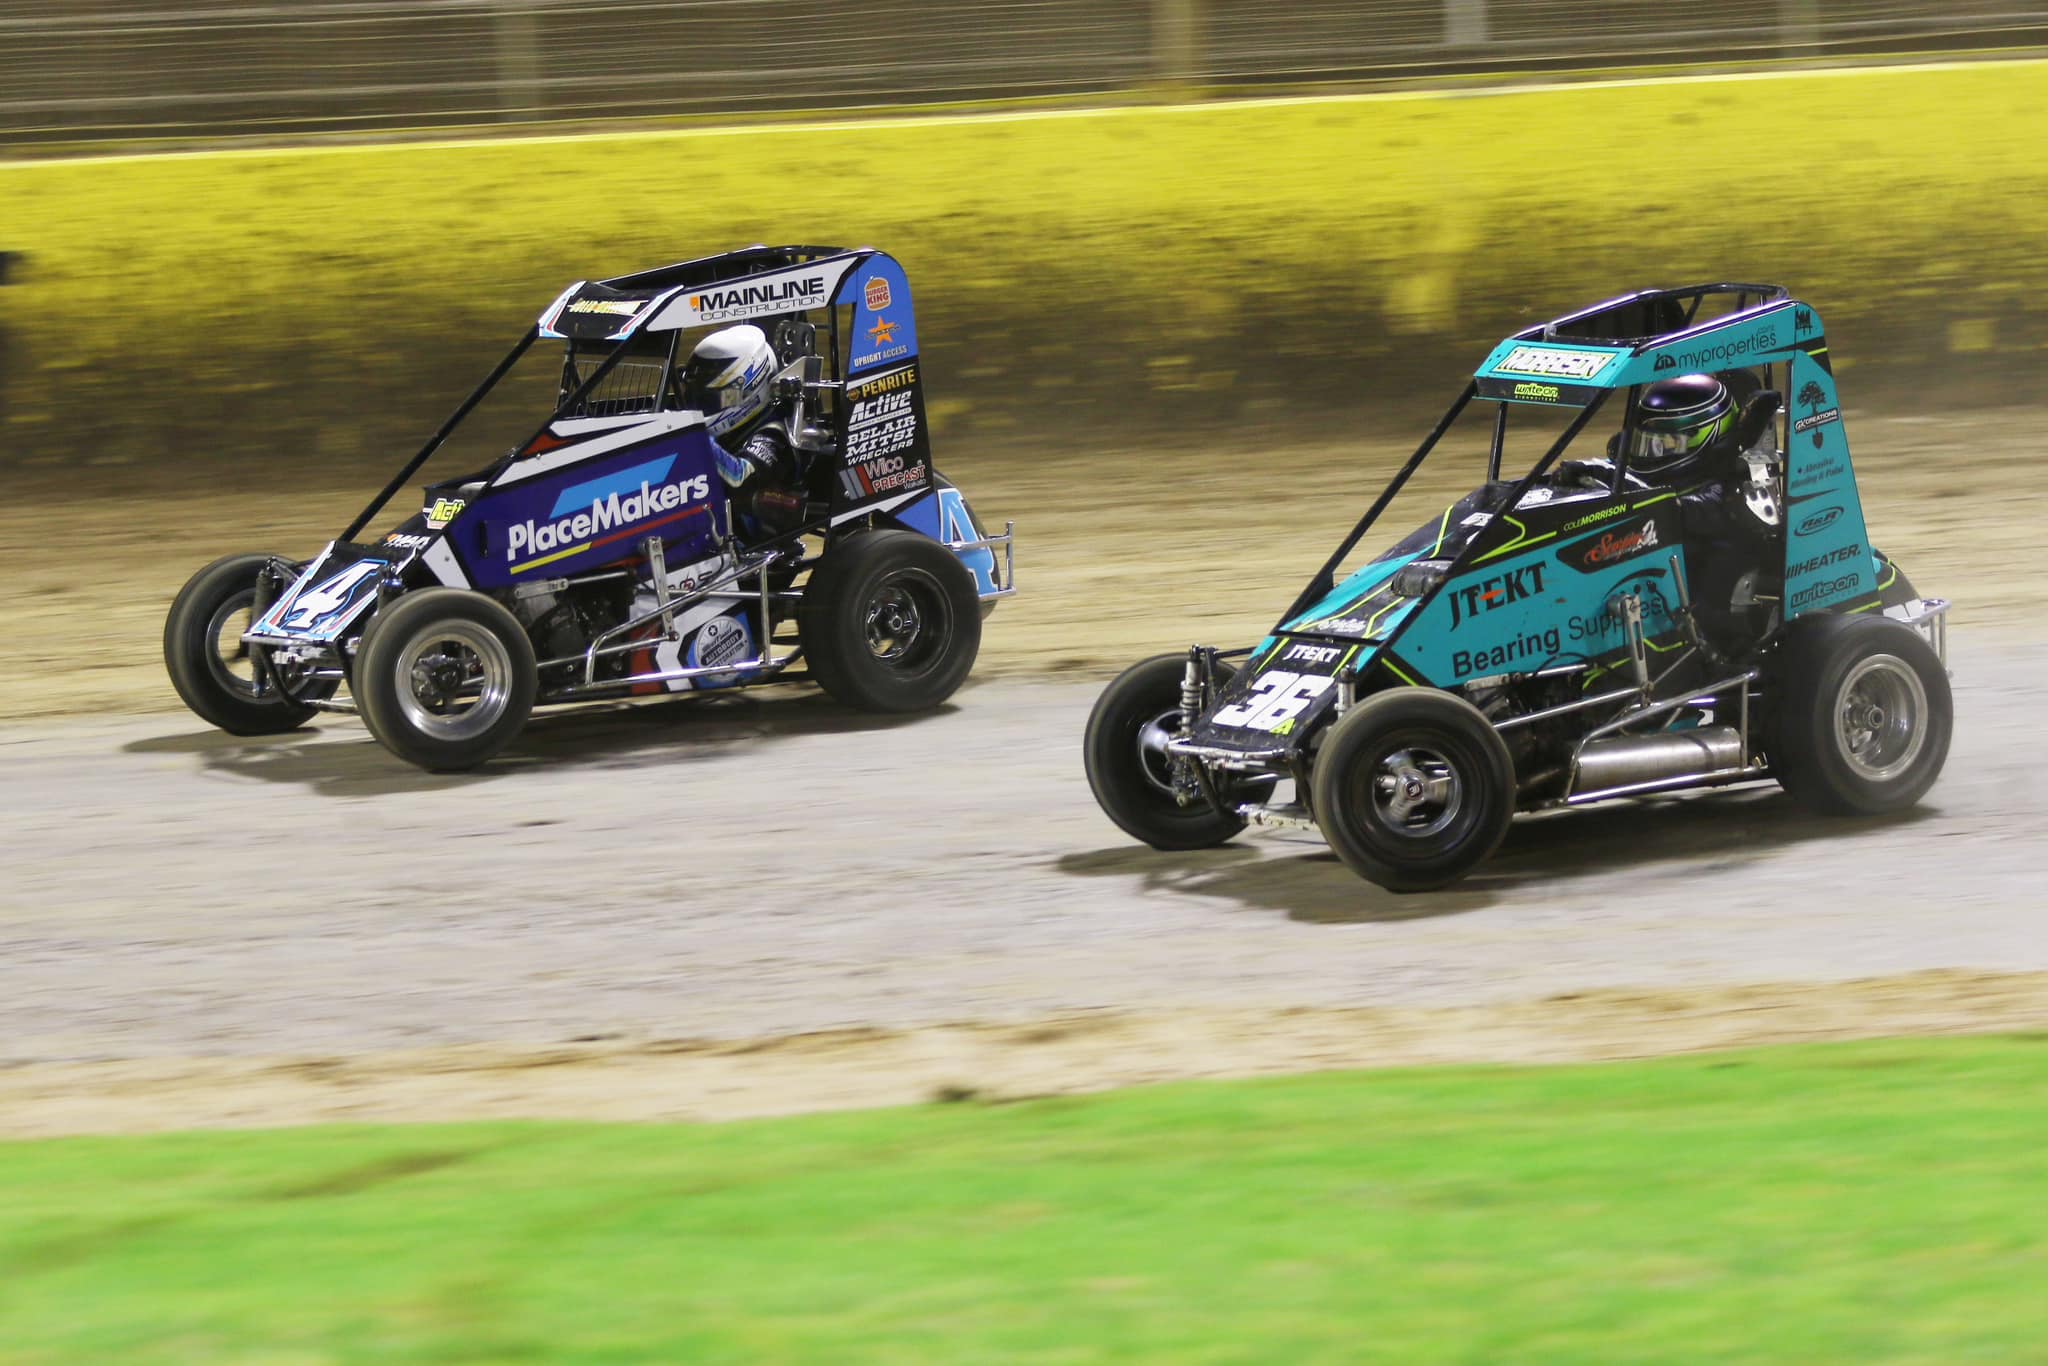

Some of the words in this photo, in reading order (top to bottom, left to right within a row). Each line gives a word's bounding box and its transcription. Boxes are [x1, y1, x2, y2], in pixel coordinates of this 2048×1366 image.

[700, 277, 824, 312] MAINLINE
[701, 295, 825, 321] CONSTRUCTION
[867, 292, 889, 305] KING
[853, 352, 882, 368] UPRIGHT
[882, 345, 908, 359] ACCESS
[1679, 332, 1777, 369] myproperties
[862, 369, 916, 398] PENRITE
[849, 390, 912, 424] Active
[845, 426, 916, 458] MITSI
[847, 439, 914, 466] WRECKERS
[872, 465, 926, 494] PRECAST
[507, 474, 710, 561] PlaceMakers
[1448, 561, 1547, 632] JTEKT
[1283, 644, 1342, 663] JTEKT
[1453, 627, 1560, 678] Bearing
[1211, 670, 1335, 731] 36
